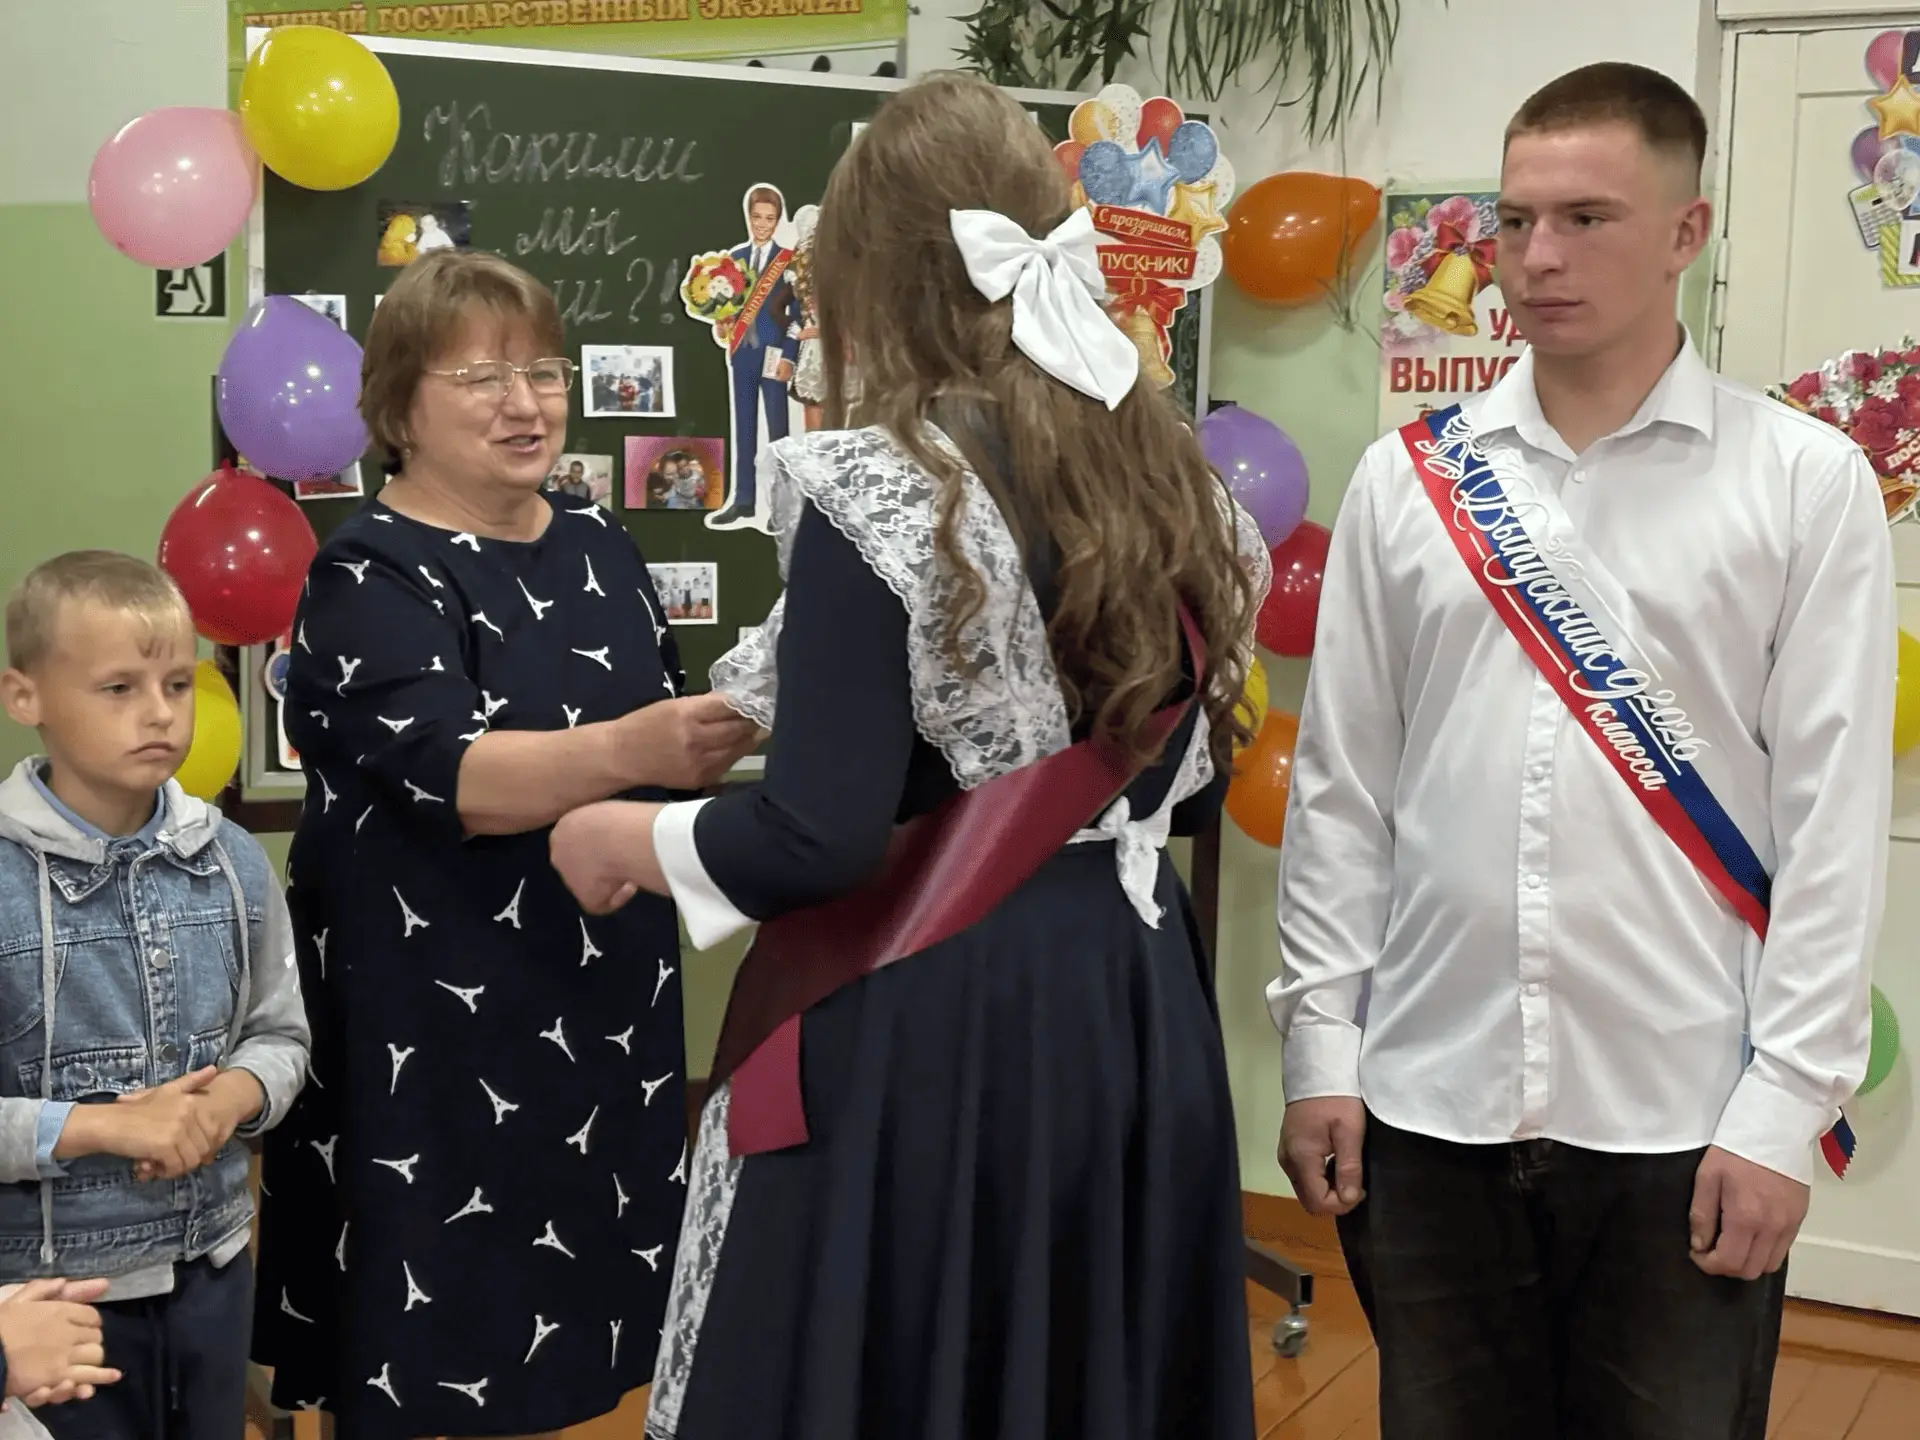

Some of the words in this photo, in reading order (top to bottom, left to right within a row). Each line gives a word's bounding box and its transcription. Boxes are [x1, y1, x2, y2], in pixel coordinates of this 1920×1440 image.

[515, 207, 637, 255] мы
[1099, 208, 1109, 222] С
[1451, 465, 1618, 671] Выпускник
[1584, 701, 1667, 791] класса
[1633, 689, 1711, 761] 2026
